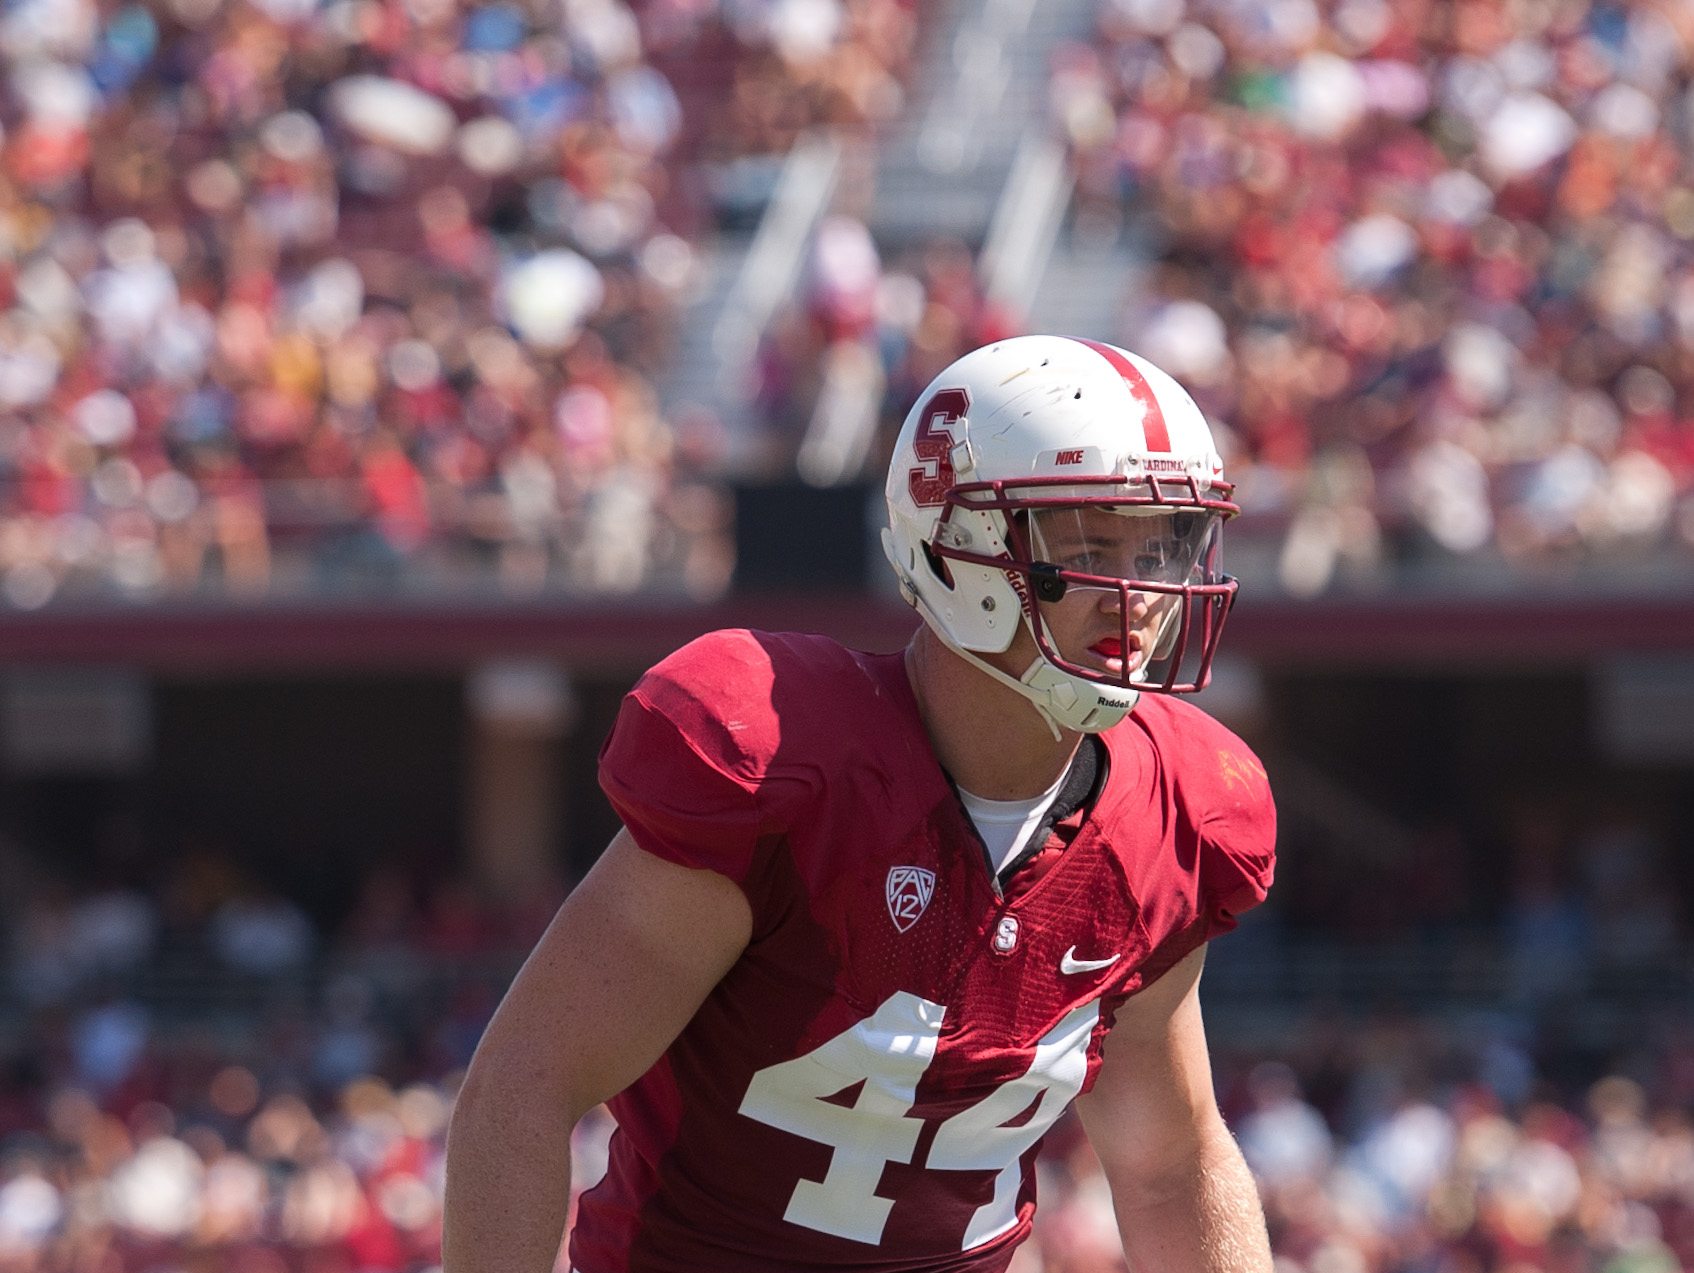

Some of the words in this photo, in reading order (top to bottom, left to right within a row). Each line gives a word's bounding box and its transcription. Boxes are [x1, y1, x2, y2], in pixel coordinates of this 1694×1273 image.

[1054, 449, 1084, 466] NIKE
[1097, 696, 1130, 708] Riddell
[890, 869, 932, 908] PAC
[895, 894, 919, 919] 12
[994, 917, 1019, 952] S
[737, 990, 1101, 1252] 44
